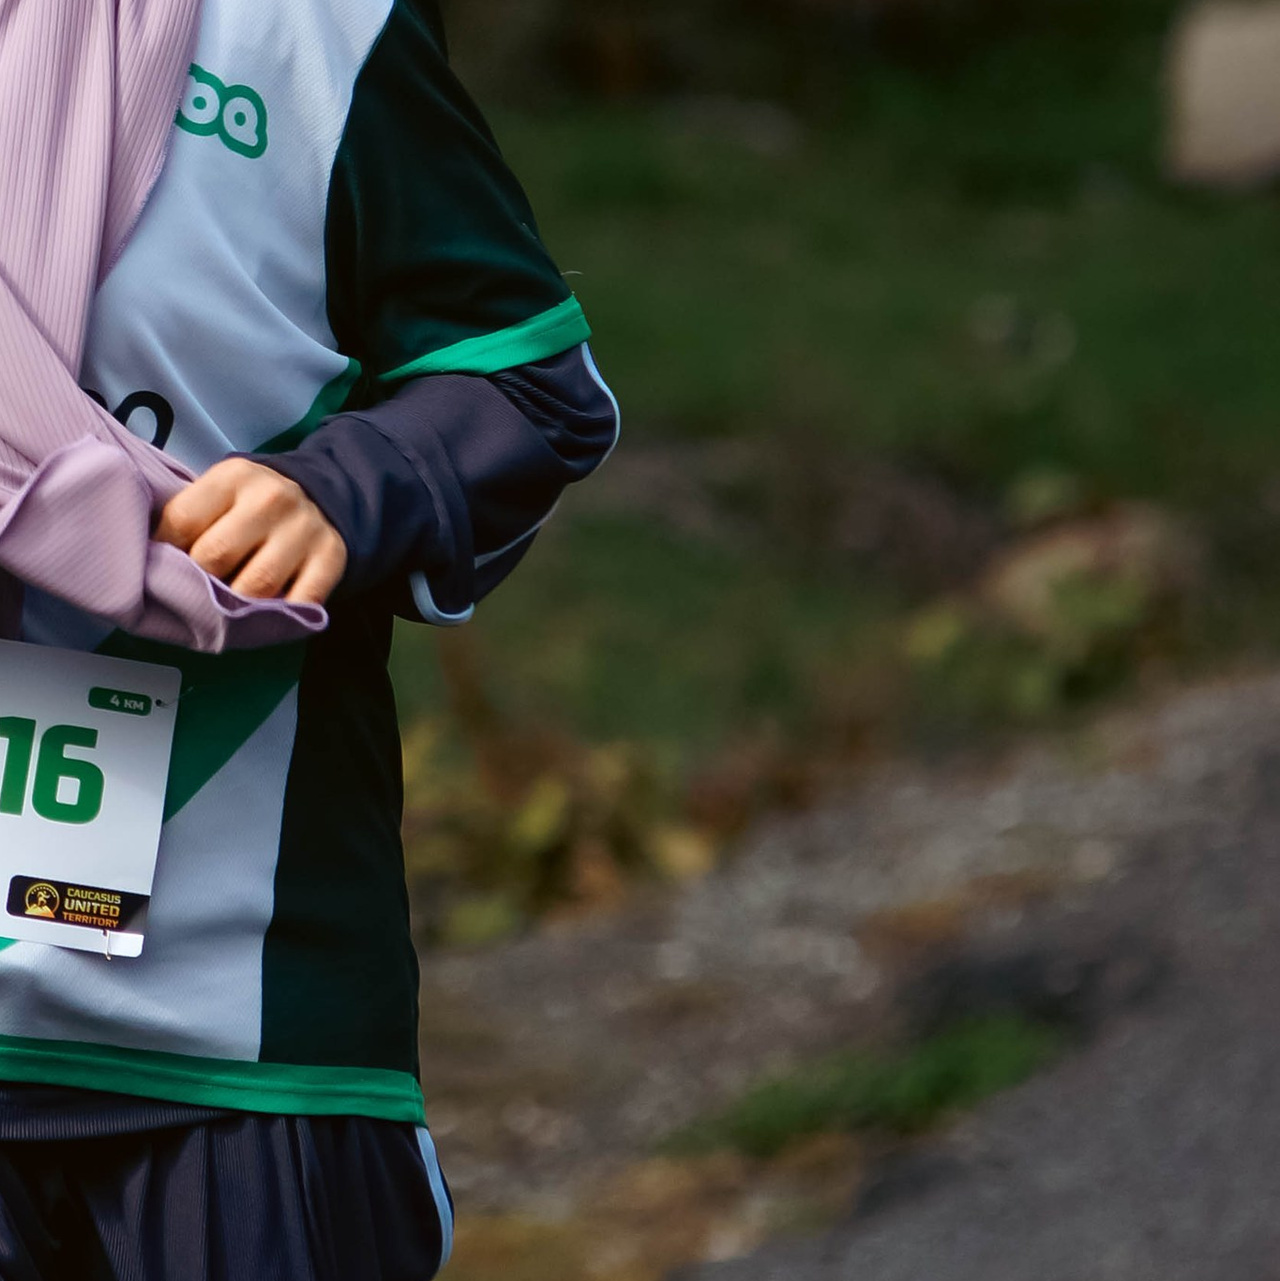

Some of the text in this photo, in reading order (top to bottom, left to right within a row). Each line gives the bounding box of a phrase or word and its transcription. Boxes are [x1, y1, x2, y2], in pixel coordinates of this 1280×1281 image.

[109, 694, 120, 707] 4
[66, 887, 121, 904] CAUCASUS
[64, 898, 120, 917] UNITED
[62, 911, 119, 928] TERRITORY
